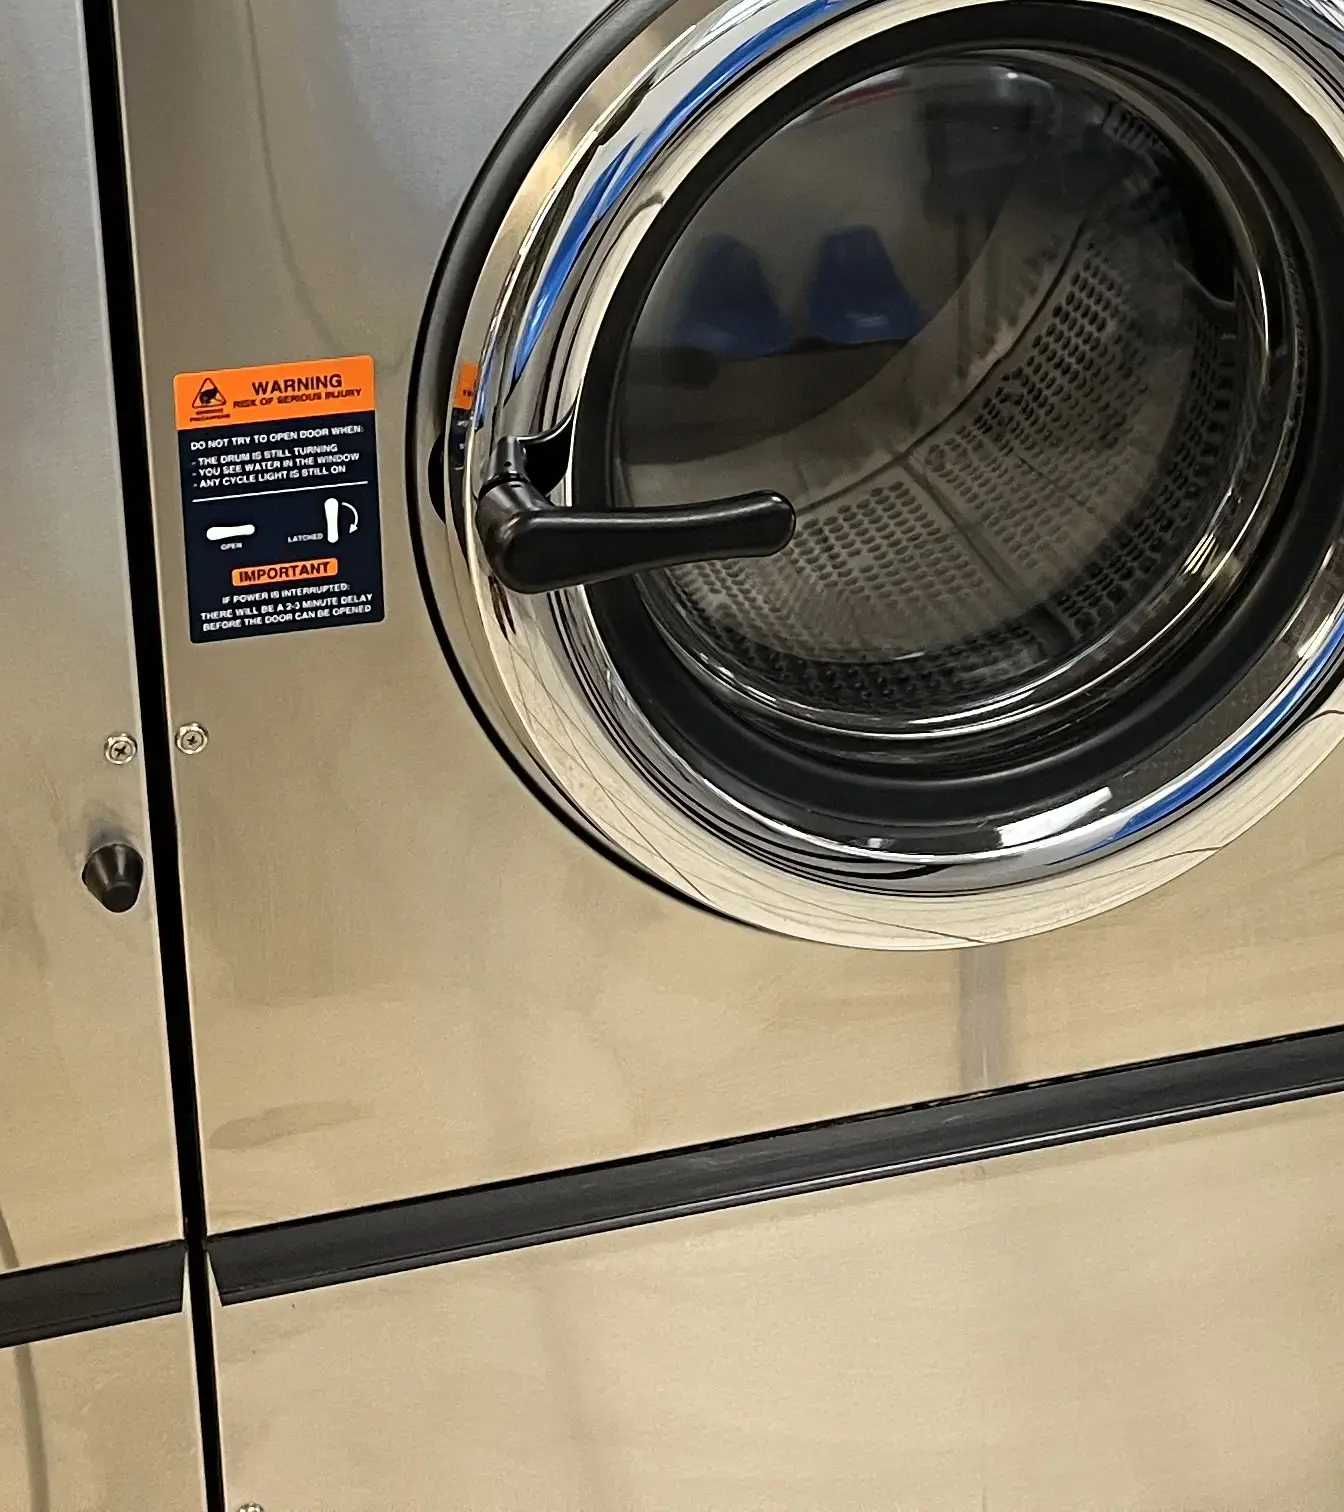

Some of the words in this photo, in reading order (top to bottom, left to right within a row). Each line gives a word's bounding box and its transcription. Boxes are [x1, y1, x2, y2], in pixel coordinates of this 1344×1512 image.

[252, 374, 342, 395] WARNING
[233, 399, 256, 408] RISK
[260, 397, 273, 406] OF
[277, 393, 322, 405] SERIOUS
[325, 389, 361, 399] INJURY
[191, 441, 206, 450] DO
[208, 439, 229, 449] NOT
[231, 436, 250, 447] TRY
[253, 434, 267, 443] TO
[269, 432, 297, 443] OPEN
[299, 428, 329, 438] DOOR
[198, 456, 218, 465] THE
[220, 453, 249, 464] DRUM
[252, 451, 262, 460] IS
[264, 448, 291, 459] STILL
[294, 444, 338, 456] TURNING
[199, 467, 220, 477] YOU
[223, 464, 241, 474] SEE
[244, 460, 281, 472] WATER
[283, 459, 293, 467] IN
[295, 457, 314, 466] THE
[317, 453, 360, 464] WINDOW
[199, 478, 220, 488] ANY
[223, 474, 256, 486] CYCLE
[258, 471, 287, 482] LIGHT
[290, 469, 299, 479] IS
[301, 467, 329, 478] STILL
[331, 464, 346, 474] ON
[239, 562, 330, 582] IMPORTANT
[201, 609, 233, 621] THERE
[235, 607, 258, 617] WILL
[261, 605, 275, 614] BE
[277, 603, 284, 612] A
[286, 601, 300, 611] 2-3
[302, 598, 338, 609] MINUTE
[340, 593, 373, 604] DELAY
[222, 596, 231, 604] IF
[233, 592, 269, 603] POWER
[270, 590, 279, 599] IS
[202, 619, 242, 632] BEFORE
[244, 616, 262, 626] THE
[264, 613, 293, 624] DOOR
[295, 611, 315, 620] CAN
[317, 609, 330, 618] BE
[332, 605, 372, 617] OPENED
